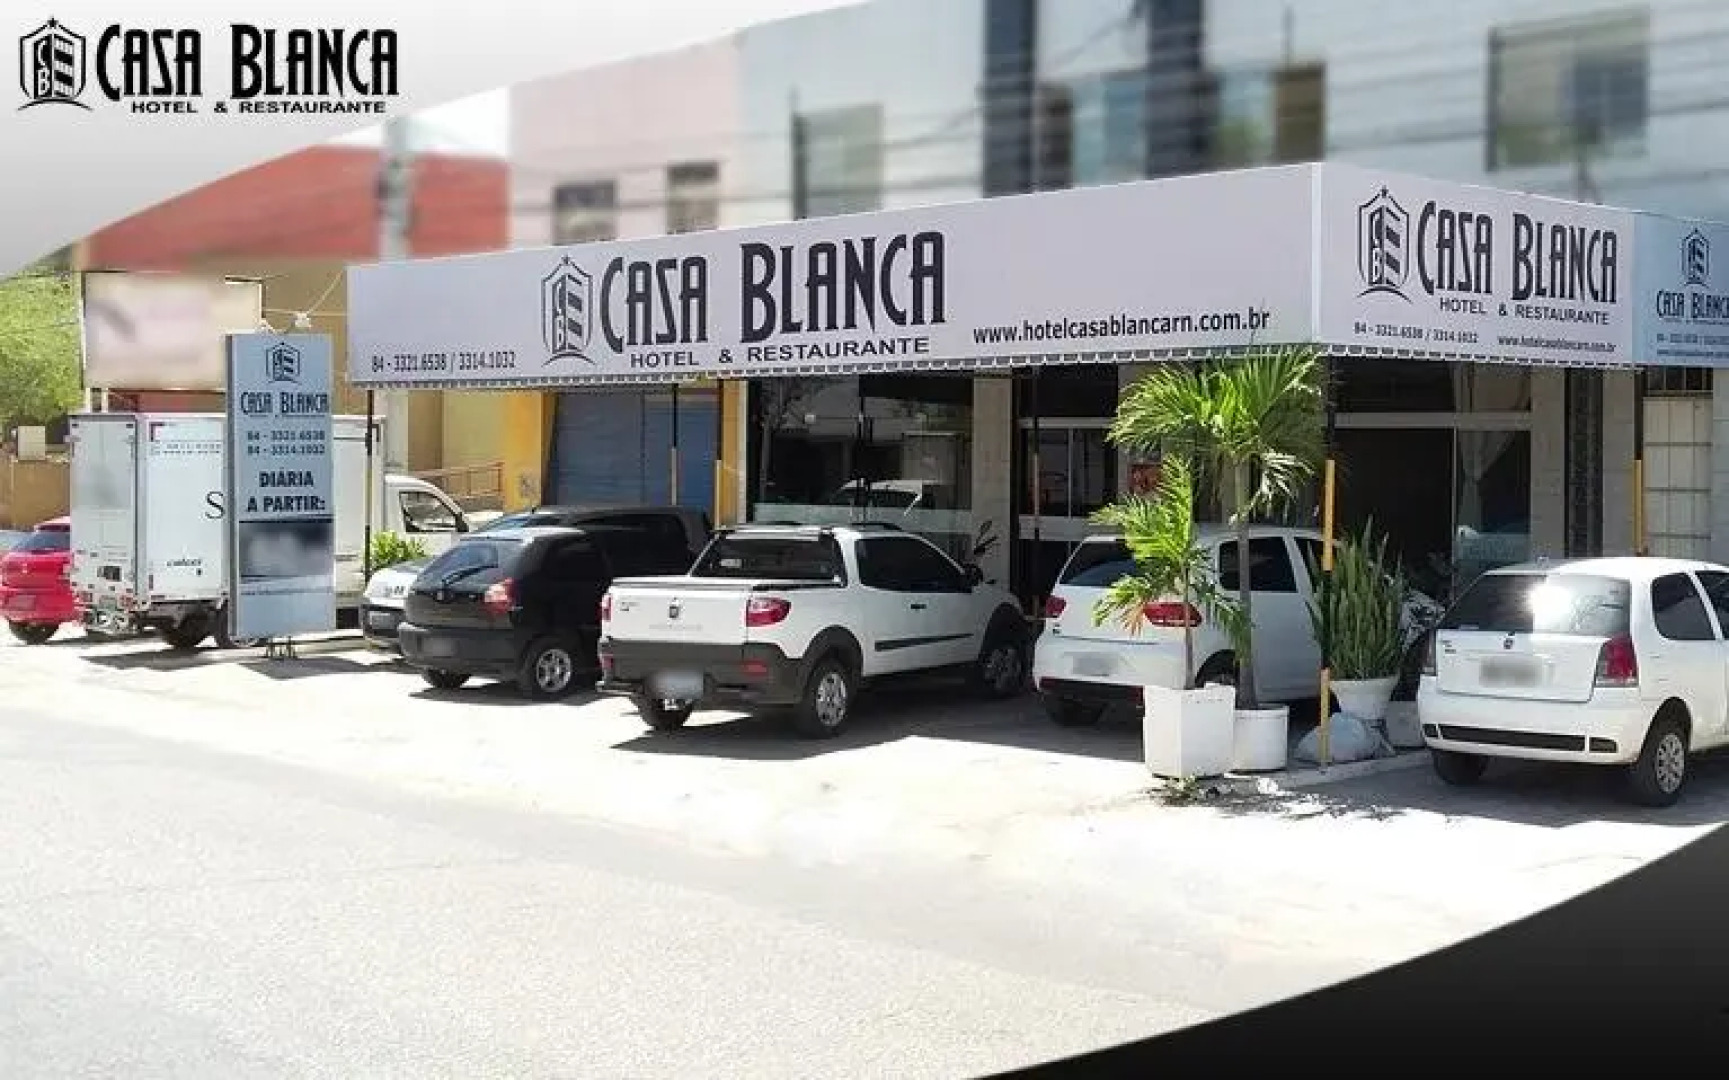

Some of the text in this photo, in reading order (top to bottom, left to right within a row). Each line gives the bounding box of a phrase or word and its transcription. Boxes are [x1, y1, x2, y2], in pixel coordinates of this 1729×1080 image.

[1418, 201, 1617, 303] CASA BLANCA
[600, 231, 945, 353] CASA BLANCA
[1691, 292, 1729, 319] BLANC
[1439, 296, 1610, 325] HOTEL & RESTAURANTE
[973, 306, 1270, 344] www.hotelcasablancarn.com.br
[372, 355, 384, 372] 84
[394, 353, 447, 371] 3321.6538
[459, 350, 516, 370] 3314.1032
[630, 336, 930, 368] HOTEL & RESTAURANTE
[241, 391, 330, 415] CASA BLANCA
[259, 467, 315, 488] DIÁRIA
[246, 495, 326, 512] A PARTIR:
